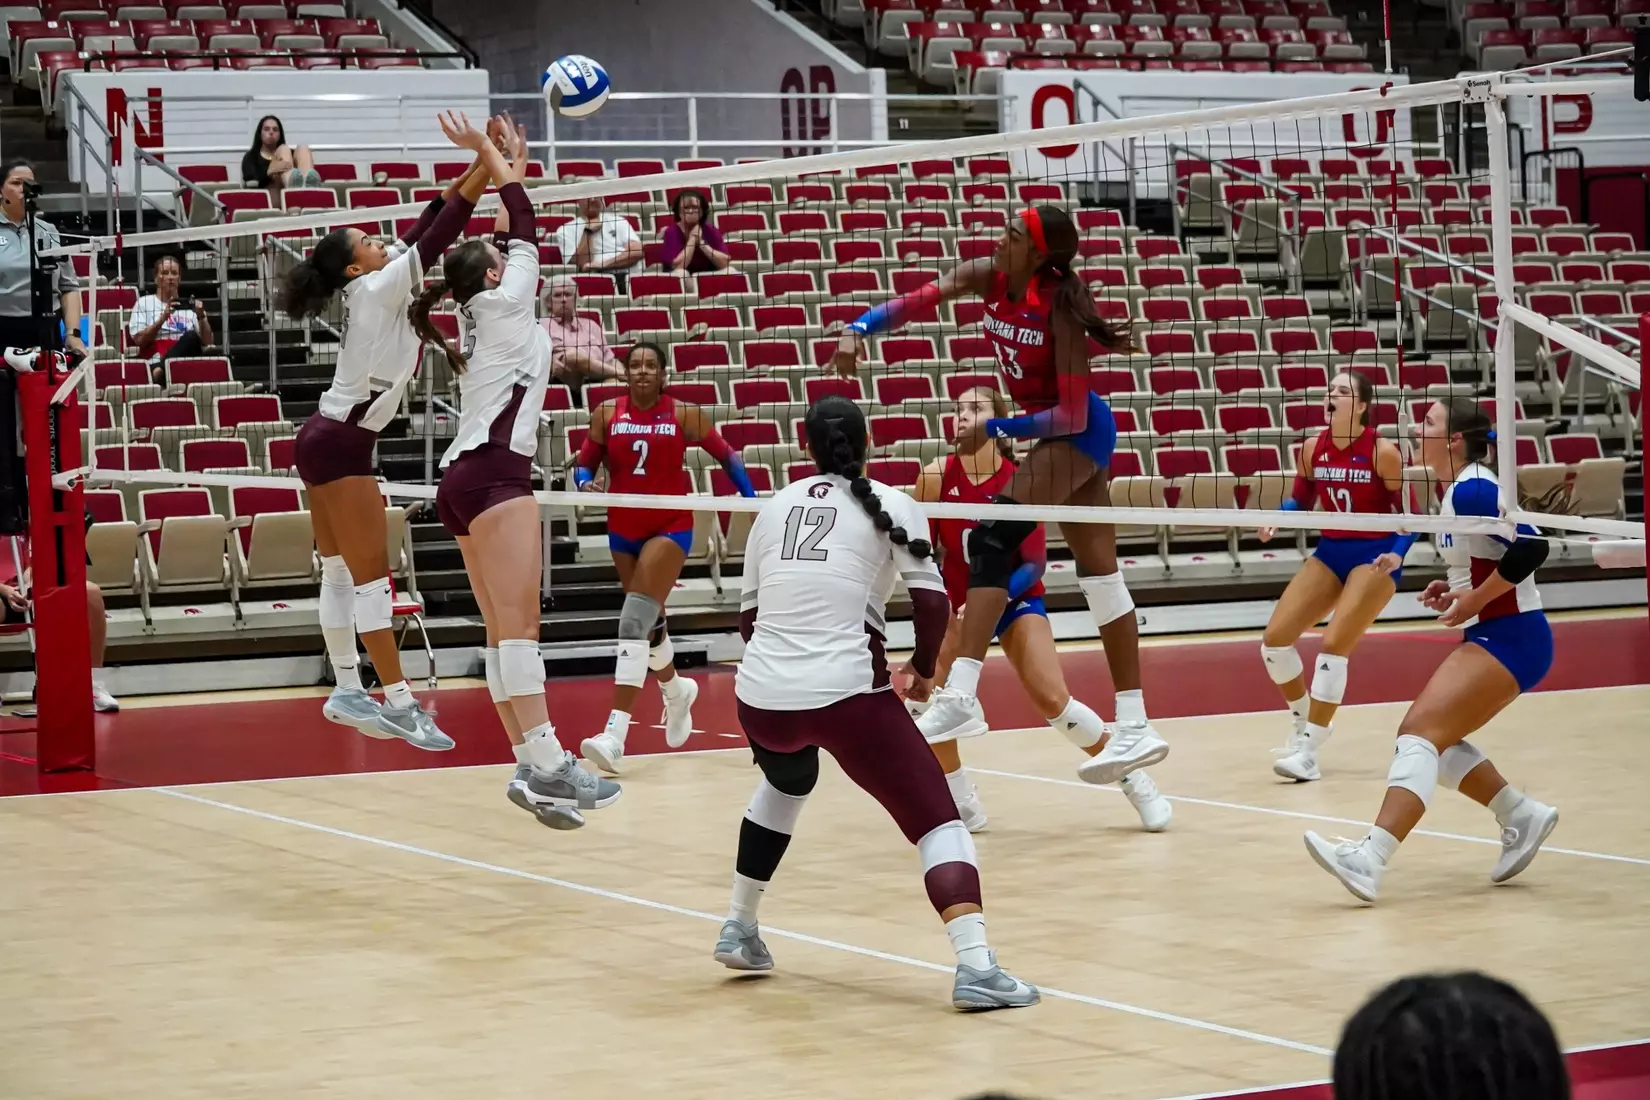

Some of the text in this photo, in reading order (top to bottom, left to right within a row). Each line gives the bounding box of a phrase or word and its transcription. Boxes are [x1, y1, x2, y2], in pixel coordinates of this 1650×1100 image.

[106, 87, 165, 167] N
[1031, 84, 1079, 158] O
[1541, 93, 1593, 152] P
[1016, 327, 1044, 346] TECH
[992, 340, 1023, 380] 13
[611, 421, 676, 437] LOUISIANA TECH
[632, 439, 649, 475] 2
[1348, 468, 1371, 483] TECH
[781, 506, 837, 561] 12
